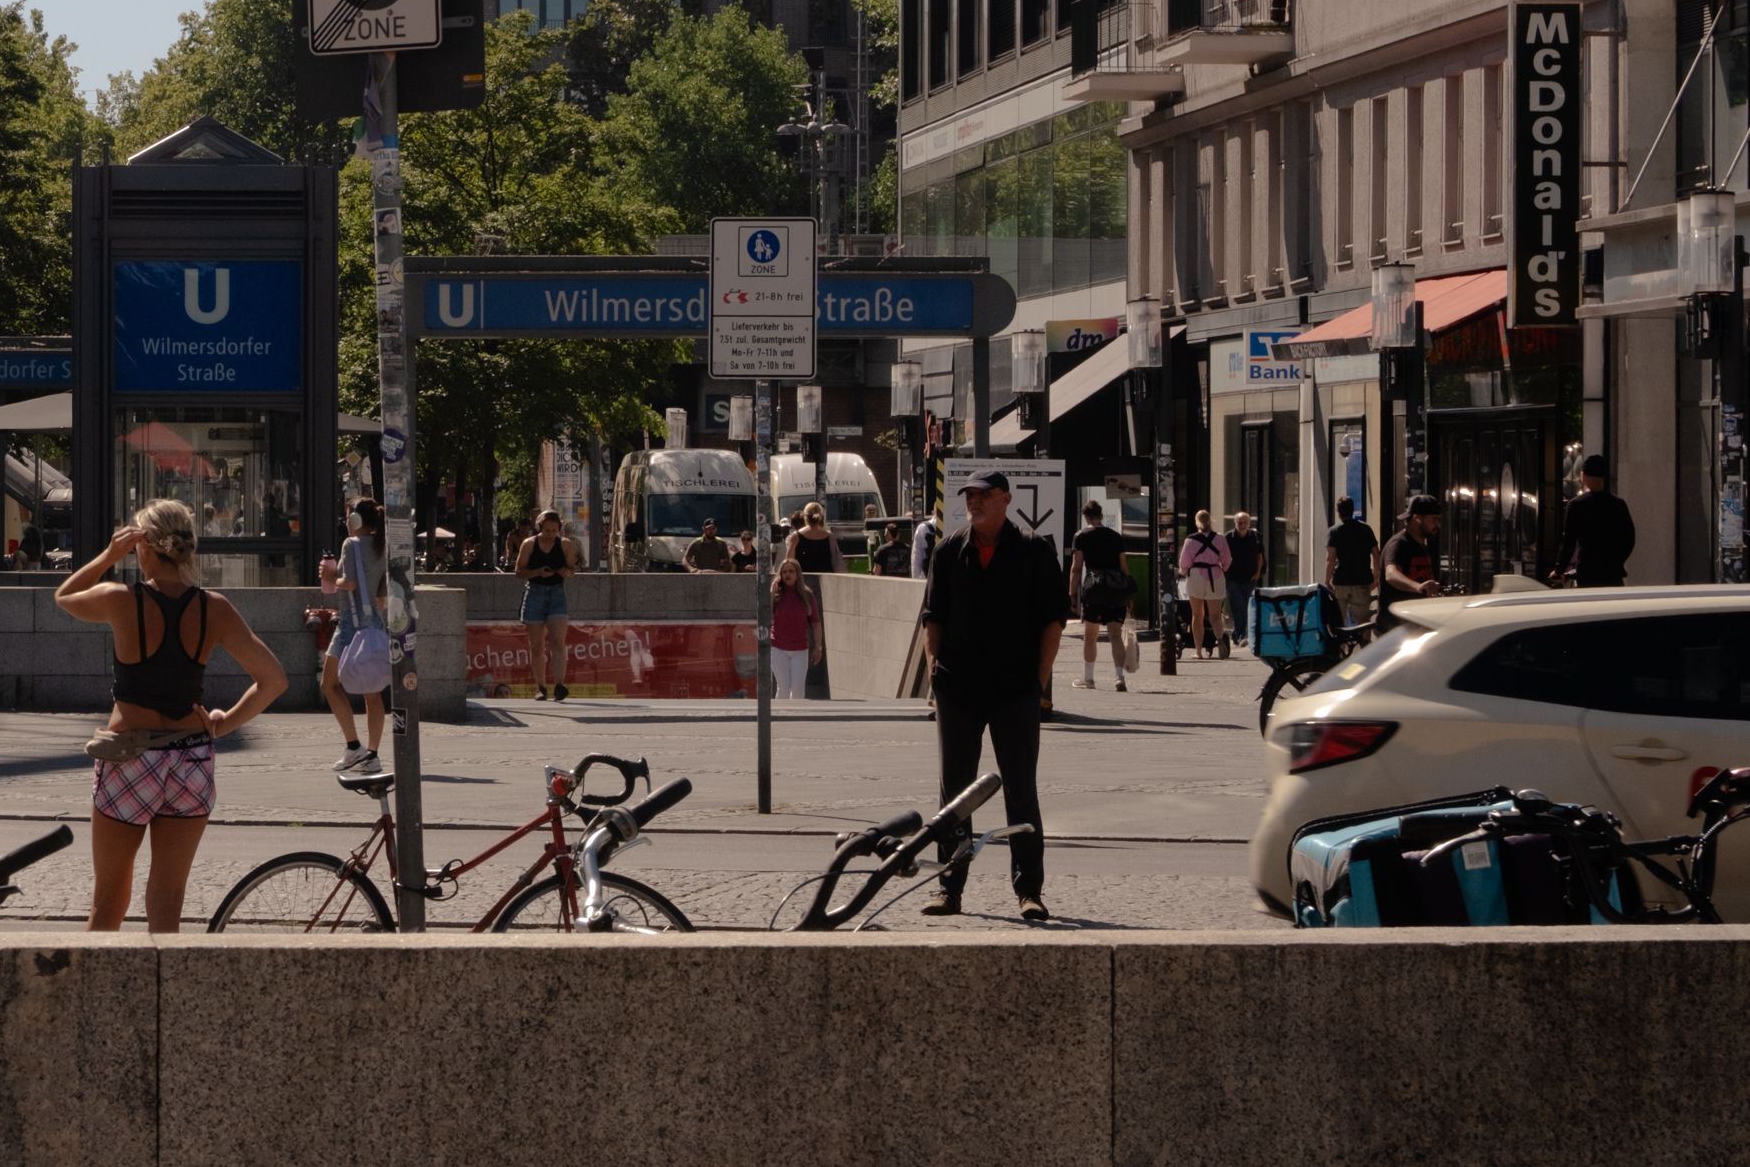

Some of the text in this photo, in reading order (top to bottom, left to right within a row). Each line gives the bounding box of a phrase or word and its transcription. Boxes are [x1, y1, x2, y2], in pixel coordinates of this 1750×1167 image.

[344, 16, 407, 41] ZONE
[751, 265, 776, 274] ZONE
[184, 268, 230, 324] U
[787, 292, 804, 301] frei
[439, 284, 914, 328] U Wilmersd traße
[731, 322, 794, 331] Lieferverkehr bis
[141, 337, 271, 355] Wilmersdorfer
[751, 335, 806, 346] Gesamtgewicht
[1066, 328, 1103, 350] dm
[780, 349, 794, 357] und
[61, 360, 72, 379] S
[177, 364, 236, 382] Straße
[730, 361, 739, 370] Sa
[783, 361, 795, 370] frei
[1250, 364, 1300, 380] Bank
[663, 479, 740, 489] TISCHLEREI
[1269, 610, 1310, 627] Wot
